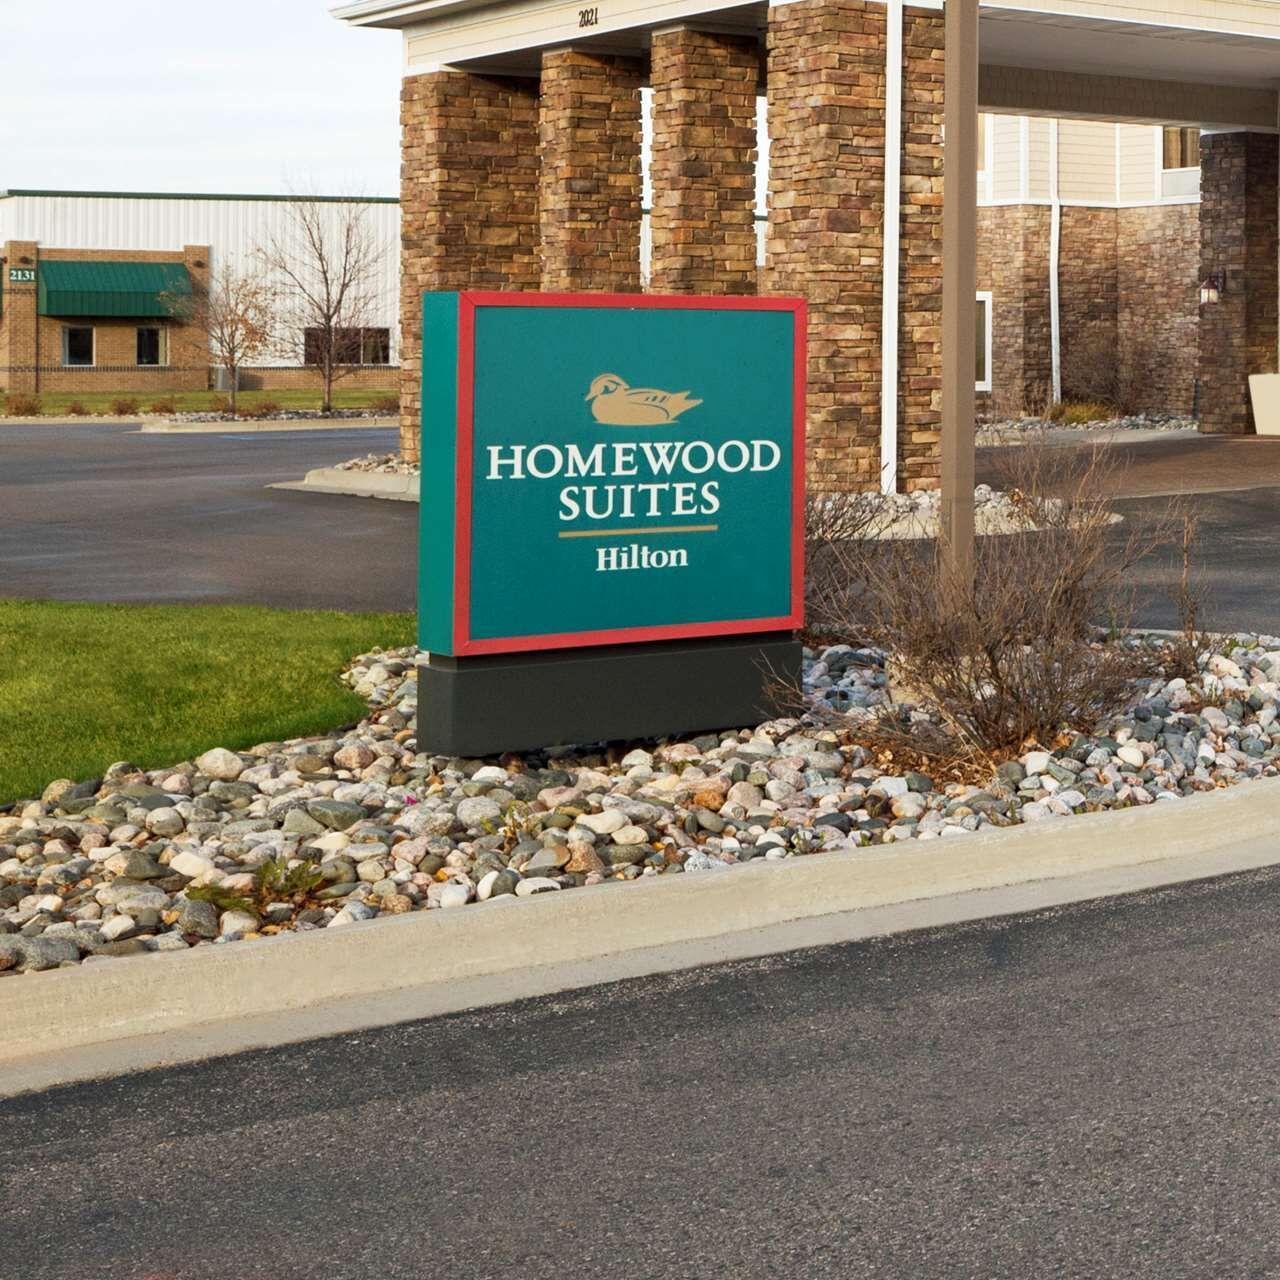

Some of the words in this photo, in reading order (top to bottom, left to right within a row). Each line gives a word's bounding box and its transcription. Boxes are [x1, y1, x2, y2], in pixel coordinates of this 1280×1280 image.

[578, 7, 598, 28] 2021
[10, 270, 35, 280] 2131
[486, 440, 782, 480] HOMEWOOD
[558, 481, 720, 521] SUITES
[595, 544, 689, 572] Hilton
